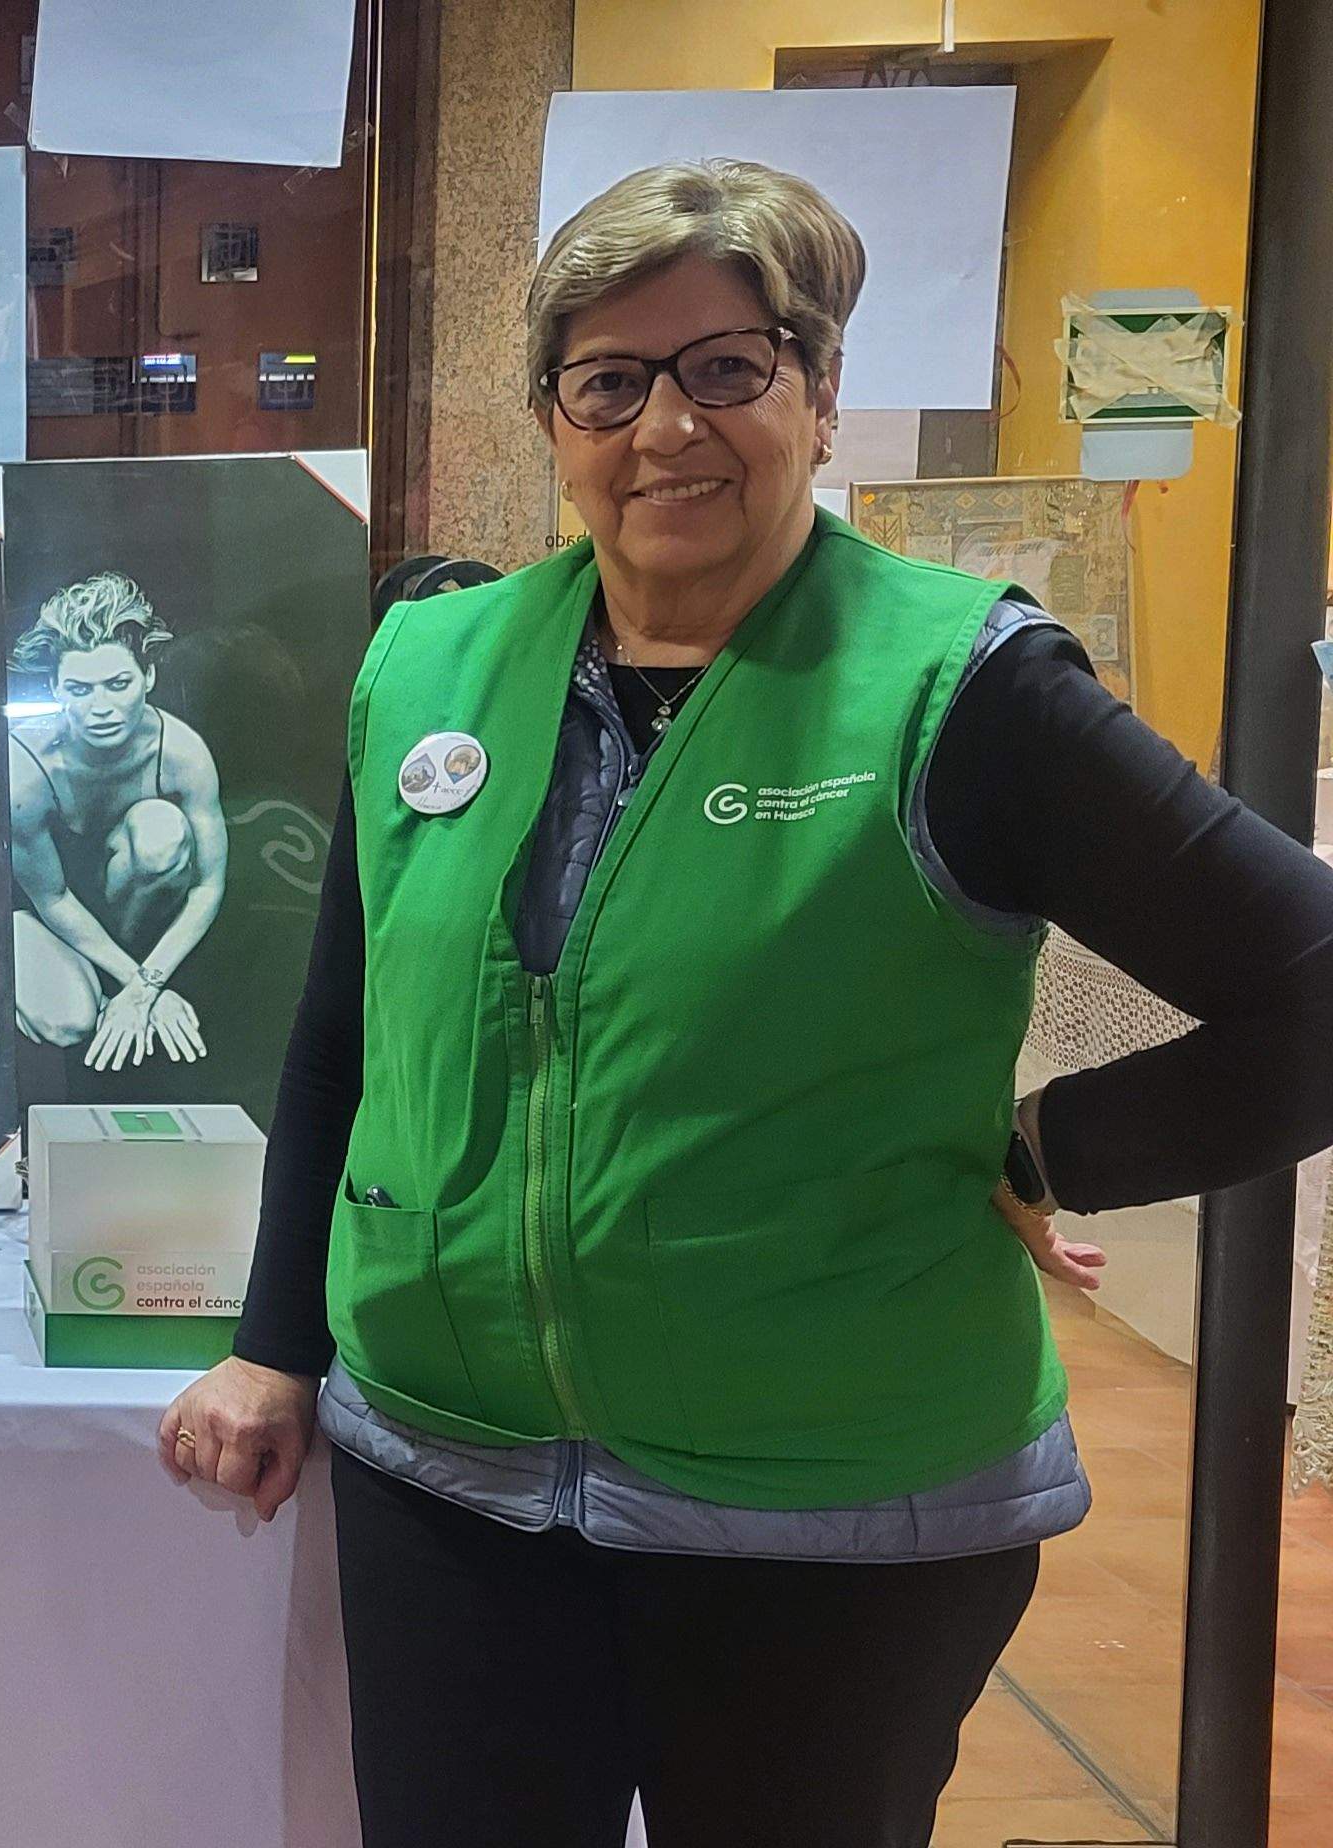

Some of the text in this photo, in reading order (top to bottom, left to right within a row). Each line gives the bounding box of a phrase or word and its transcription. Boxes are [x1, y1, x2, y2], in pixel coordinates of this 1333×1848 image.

[758, 772, 876, 798] asociación española
[756, 788, 850, 809] contra el cáncer
[755, 807, 816, 821] en Huesca
[136, 1262, 216, 1276] asociación
[136, 1279, 205, 1294] española
[136, 1295, 184, 1309] contra
[188, 1295, 201, 1309] el
